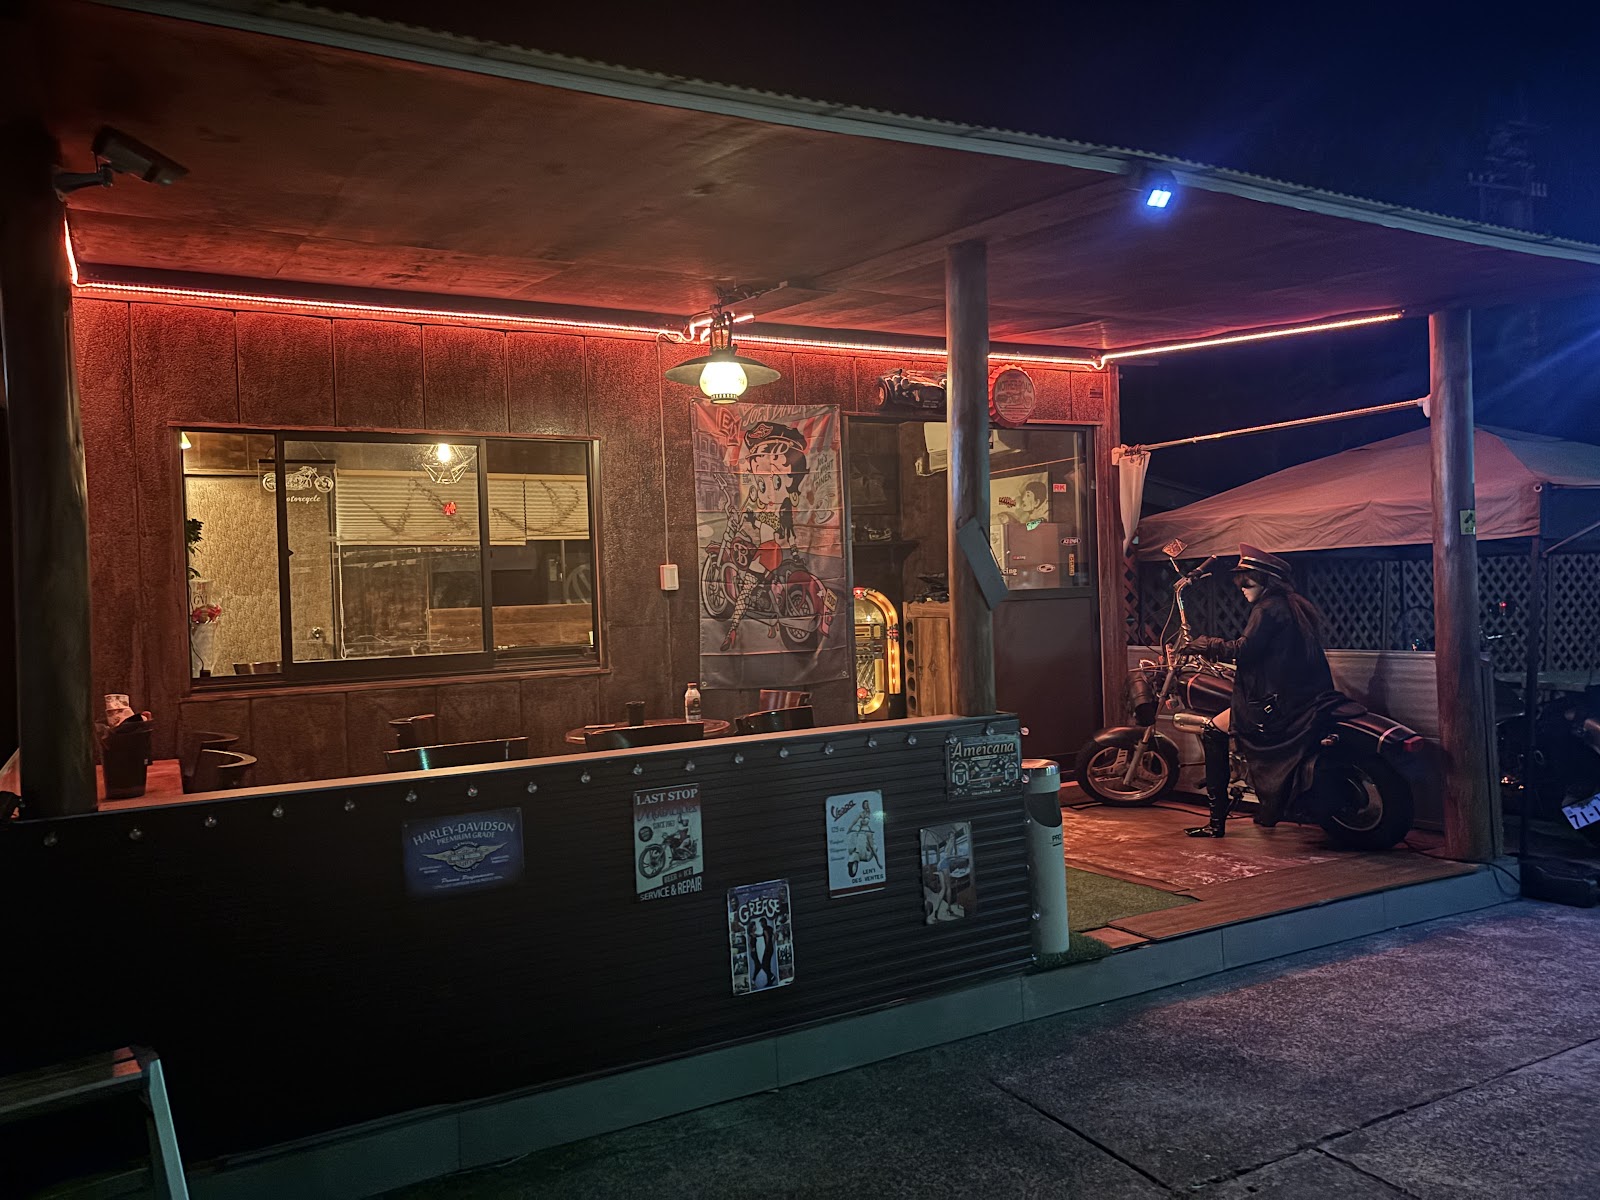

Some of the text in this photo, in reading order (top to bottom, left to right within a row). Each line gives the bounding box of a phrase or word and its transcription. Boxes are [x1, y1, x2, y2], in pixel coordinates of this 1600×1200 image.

[286, 495, 321, 504] otorcycle
[636, 788, 699, 806] LAST STOP
[830, 799, 857, 822] Vespa
[412, 821, 516, 846] HARLEY-DAVIDSON
[436, 831, 496, 846] PREMIUM GRADE
[639, 876, 703, 902] SERVICE & REPAIR
[851, 876, 862, 884] DES
[738, 898, 781, 923] GREASE
